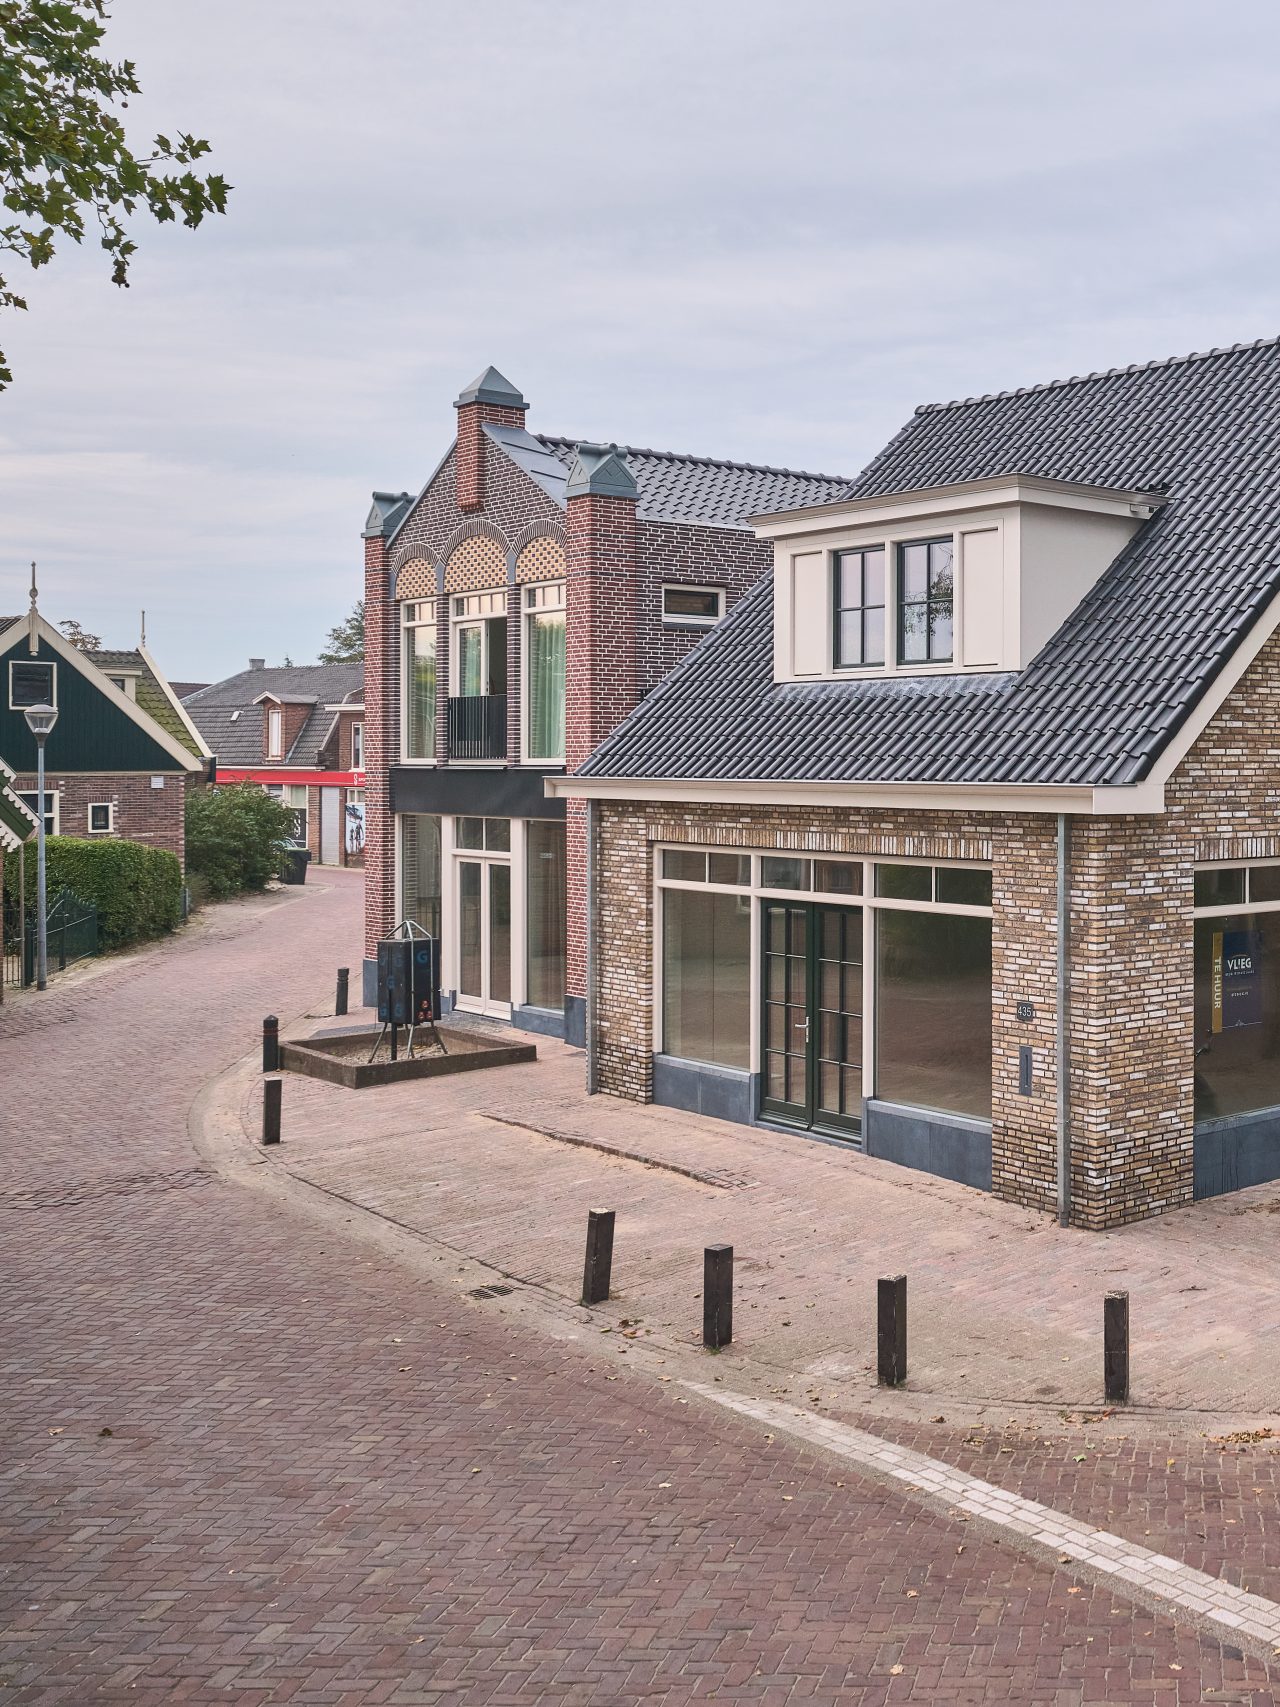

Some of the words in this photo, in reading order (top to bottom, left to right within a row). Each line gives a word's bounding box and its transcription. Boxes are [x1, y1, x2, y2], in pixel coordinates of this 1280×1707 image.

[1214, 956, 1222, 973] TE
[1227, 957, 1252, 970] VLIEG
[1214, 974, 1222, 1009] HUUR
[1018, 1006, 1032, 1017] 435
